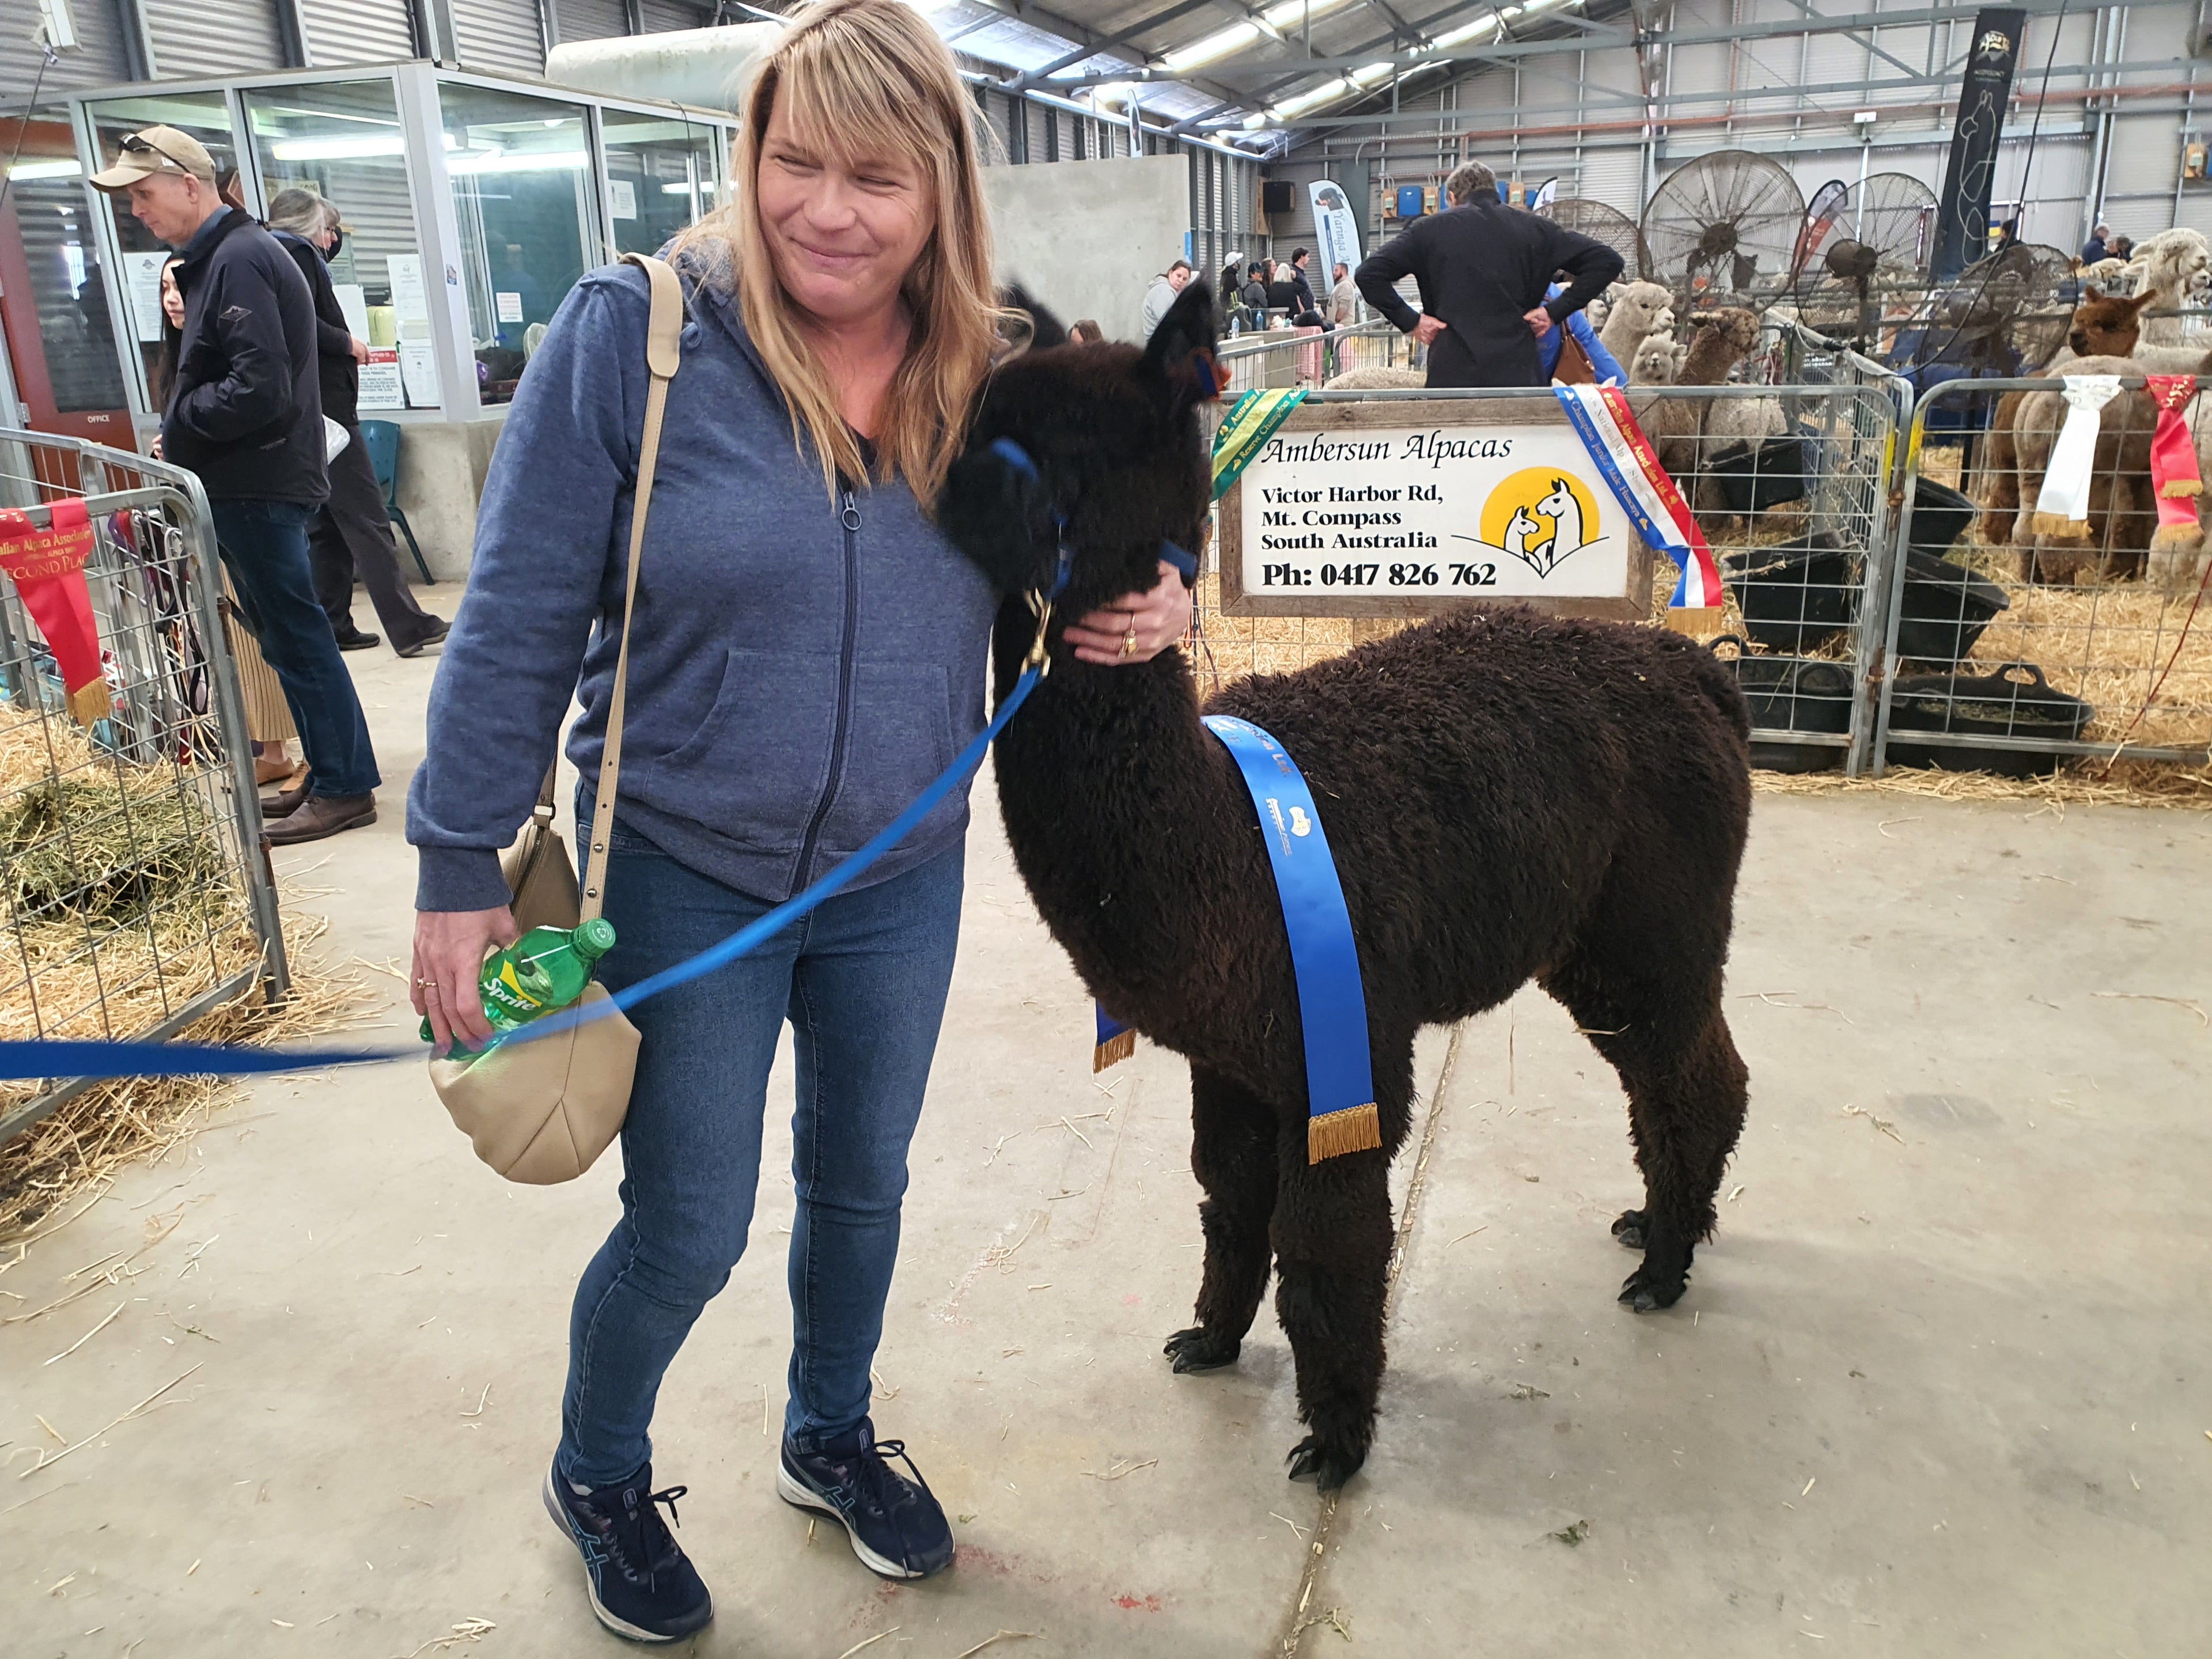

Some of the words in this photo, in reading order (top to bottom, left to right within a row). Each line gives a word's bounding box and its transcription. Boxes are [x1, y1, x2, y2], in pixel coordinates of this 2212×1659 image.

[1334, 211, 1346, 252] Yaringa
[87, 414, 111, 423] OFFICE
[1231, 393, 1257, 426] Australian
[1239, 435, 1262, 459] Reserve
[1259, 400, 1290, 435] Champion
[1570, 401, 1595, 442] Champion
[1591, 440, 1610, 467] Junior
[1260, 433, 1392, 463] Ambersun
[1400, 429, 1513, 469] Alpacas
[1261, 487, 1323, 504] Victor
[1328, 484, 1402, 502] Harbor
[1407, 484, 1443, 505] Rd,
[1261, 511, 1297, 527] Mt.
[1302, 510, 1402, 530] Compass
[24, 538, 51, 552] Alpaca
[1261, 533, 1325, 550] South
[1330, 531, 1438, 549] Australia
[2, 560, 60, 579] ECOND
[1262, 563, 1312, 586] Ph:
[1321, 563, 1380, 586] 0417
[1388, 563, 1439, 586] 826
[1448, 563, 1497, 586] 762
[483, 977, 536, 1011] Sprite
